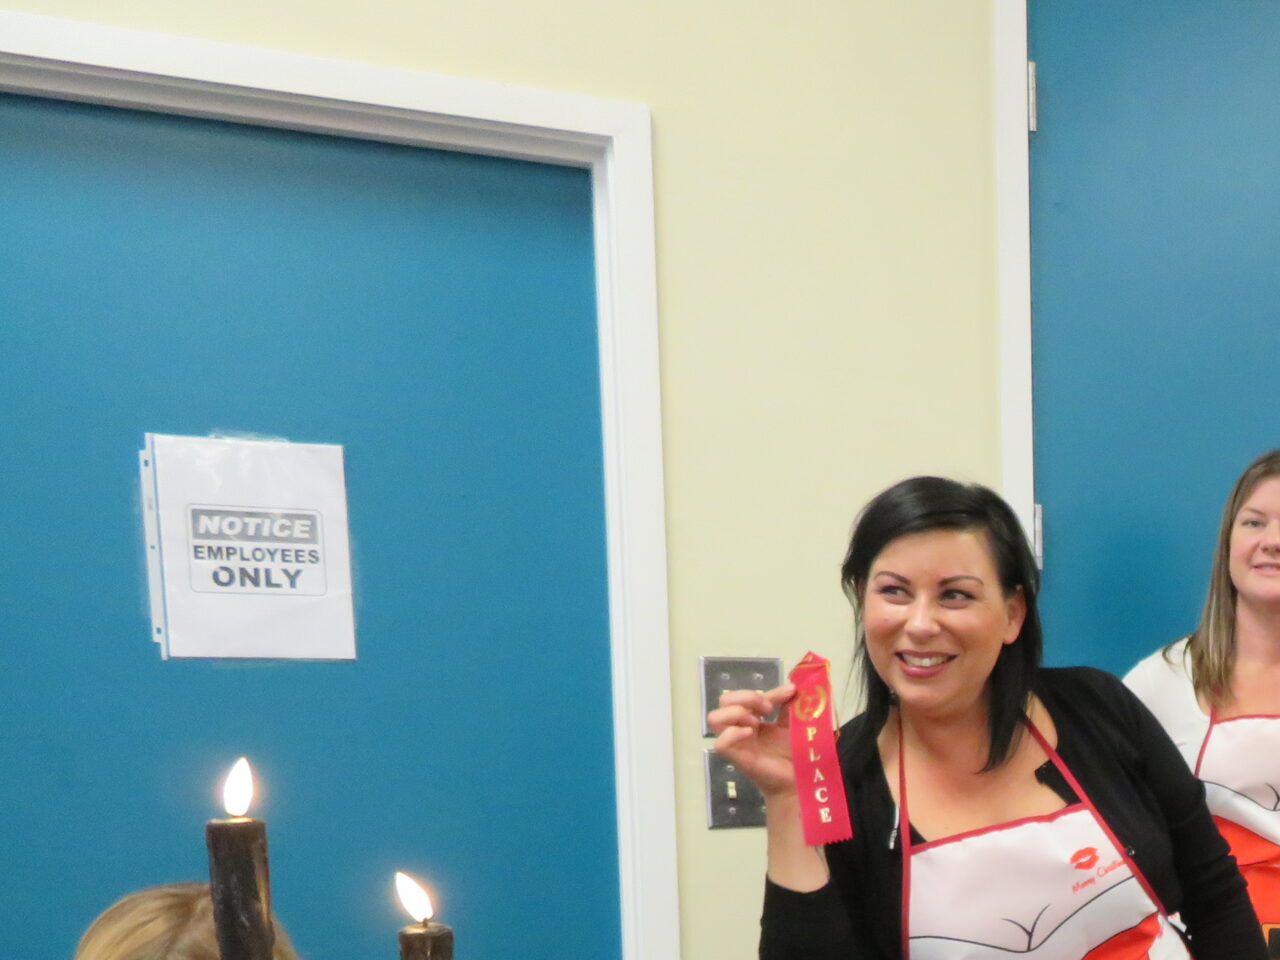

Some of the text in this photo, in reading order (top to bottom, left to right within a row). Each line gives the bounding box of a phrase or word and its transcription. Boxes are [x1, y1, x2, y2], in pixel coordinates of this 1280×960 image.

[198, 514, 312, 538] NOTICE
[193, 545, 320, 564] EMPLOYEES
[212, 566, 303, 588] ONLY
[806, 726, 832, 823] PLACE
